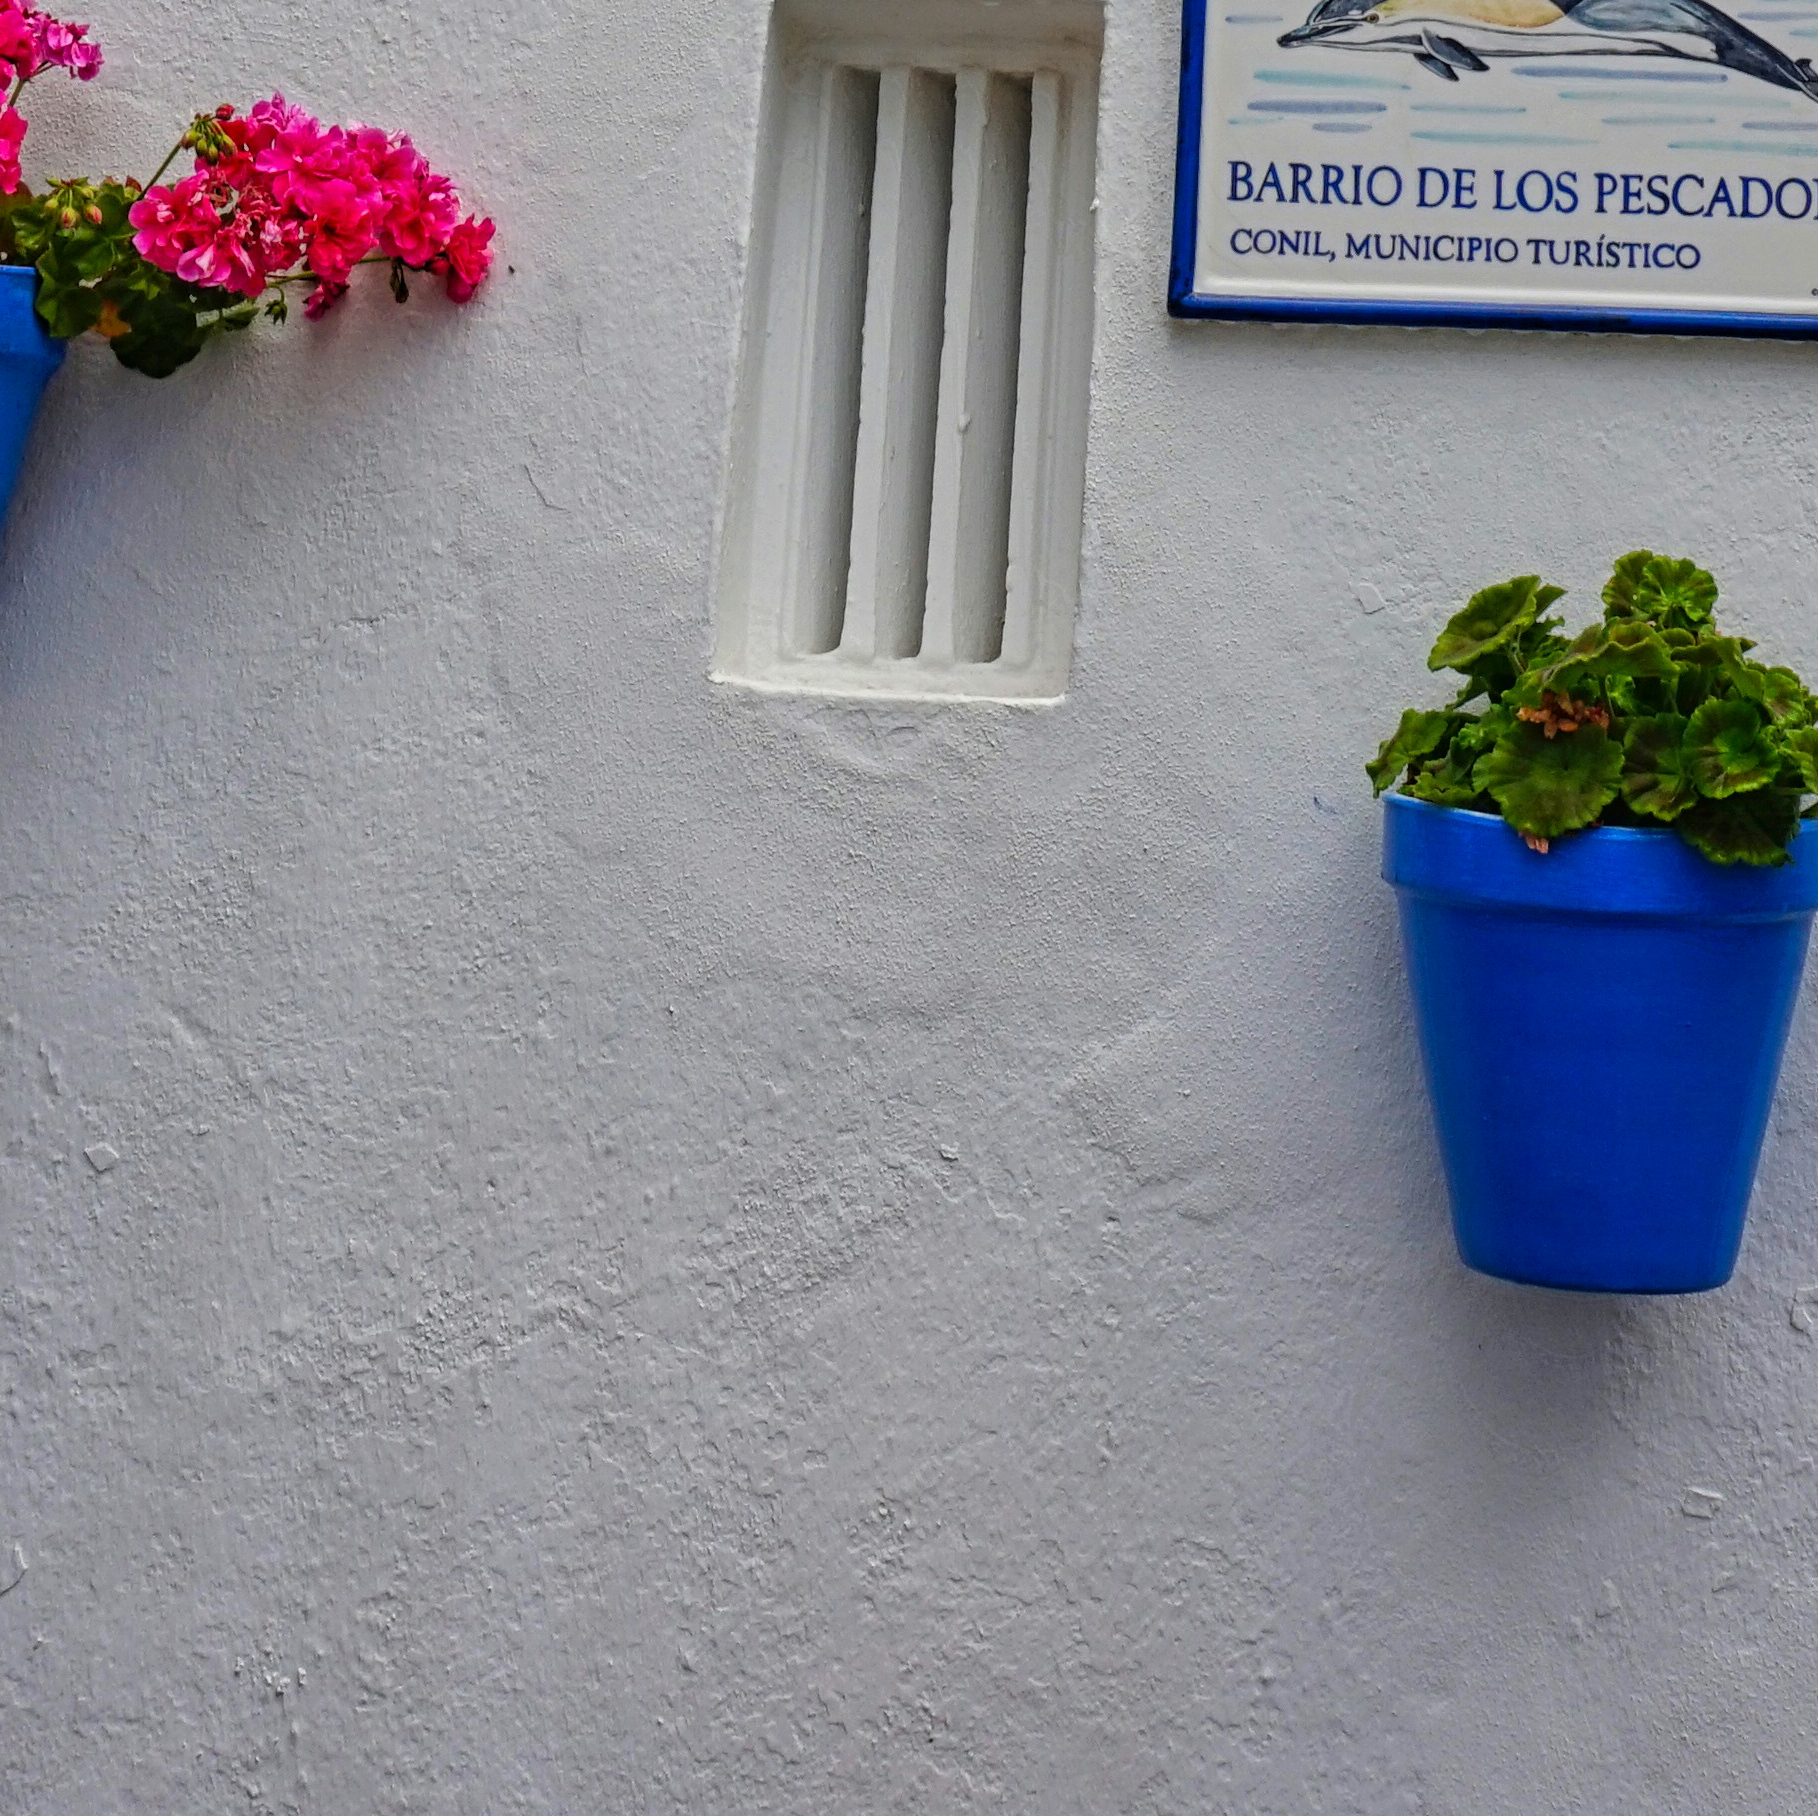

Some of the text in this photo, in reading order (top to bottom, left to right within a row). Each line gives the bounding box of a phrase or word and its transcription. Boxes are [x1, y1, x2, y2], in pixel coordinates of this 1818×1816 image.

[1227, 160, 1403, 206] BARRIO
[1416, 167, 1478, 209] DE
[1492, 169, 1579, 214] LOS
[1230, 228, 1701, 269] CONIL, MUNICIPIO TURÍSTICO
